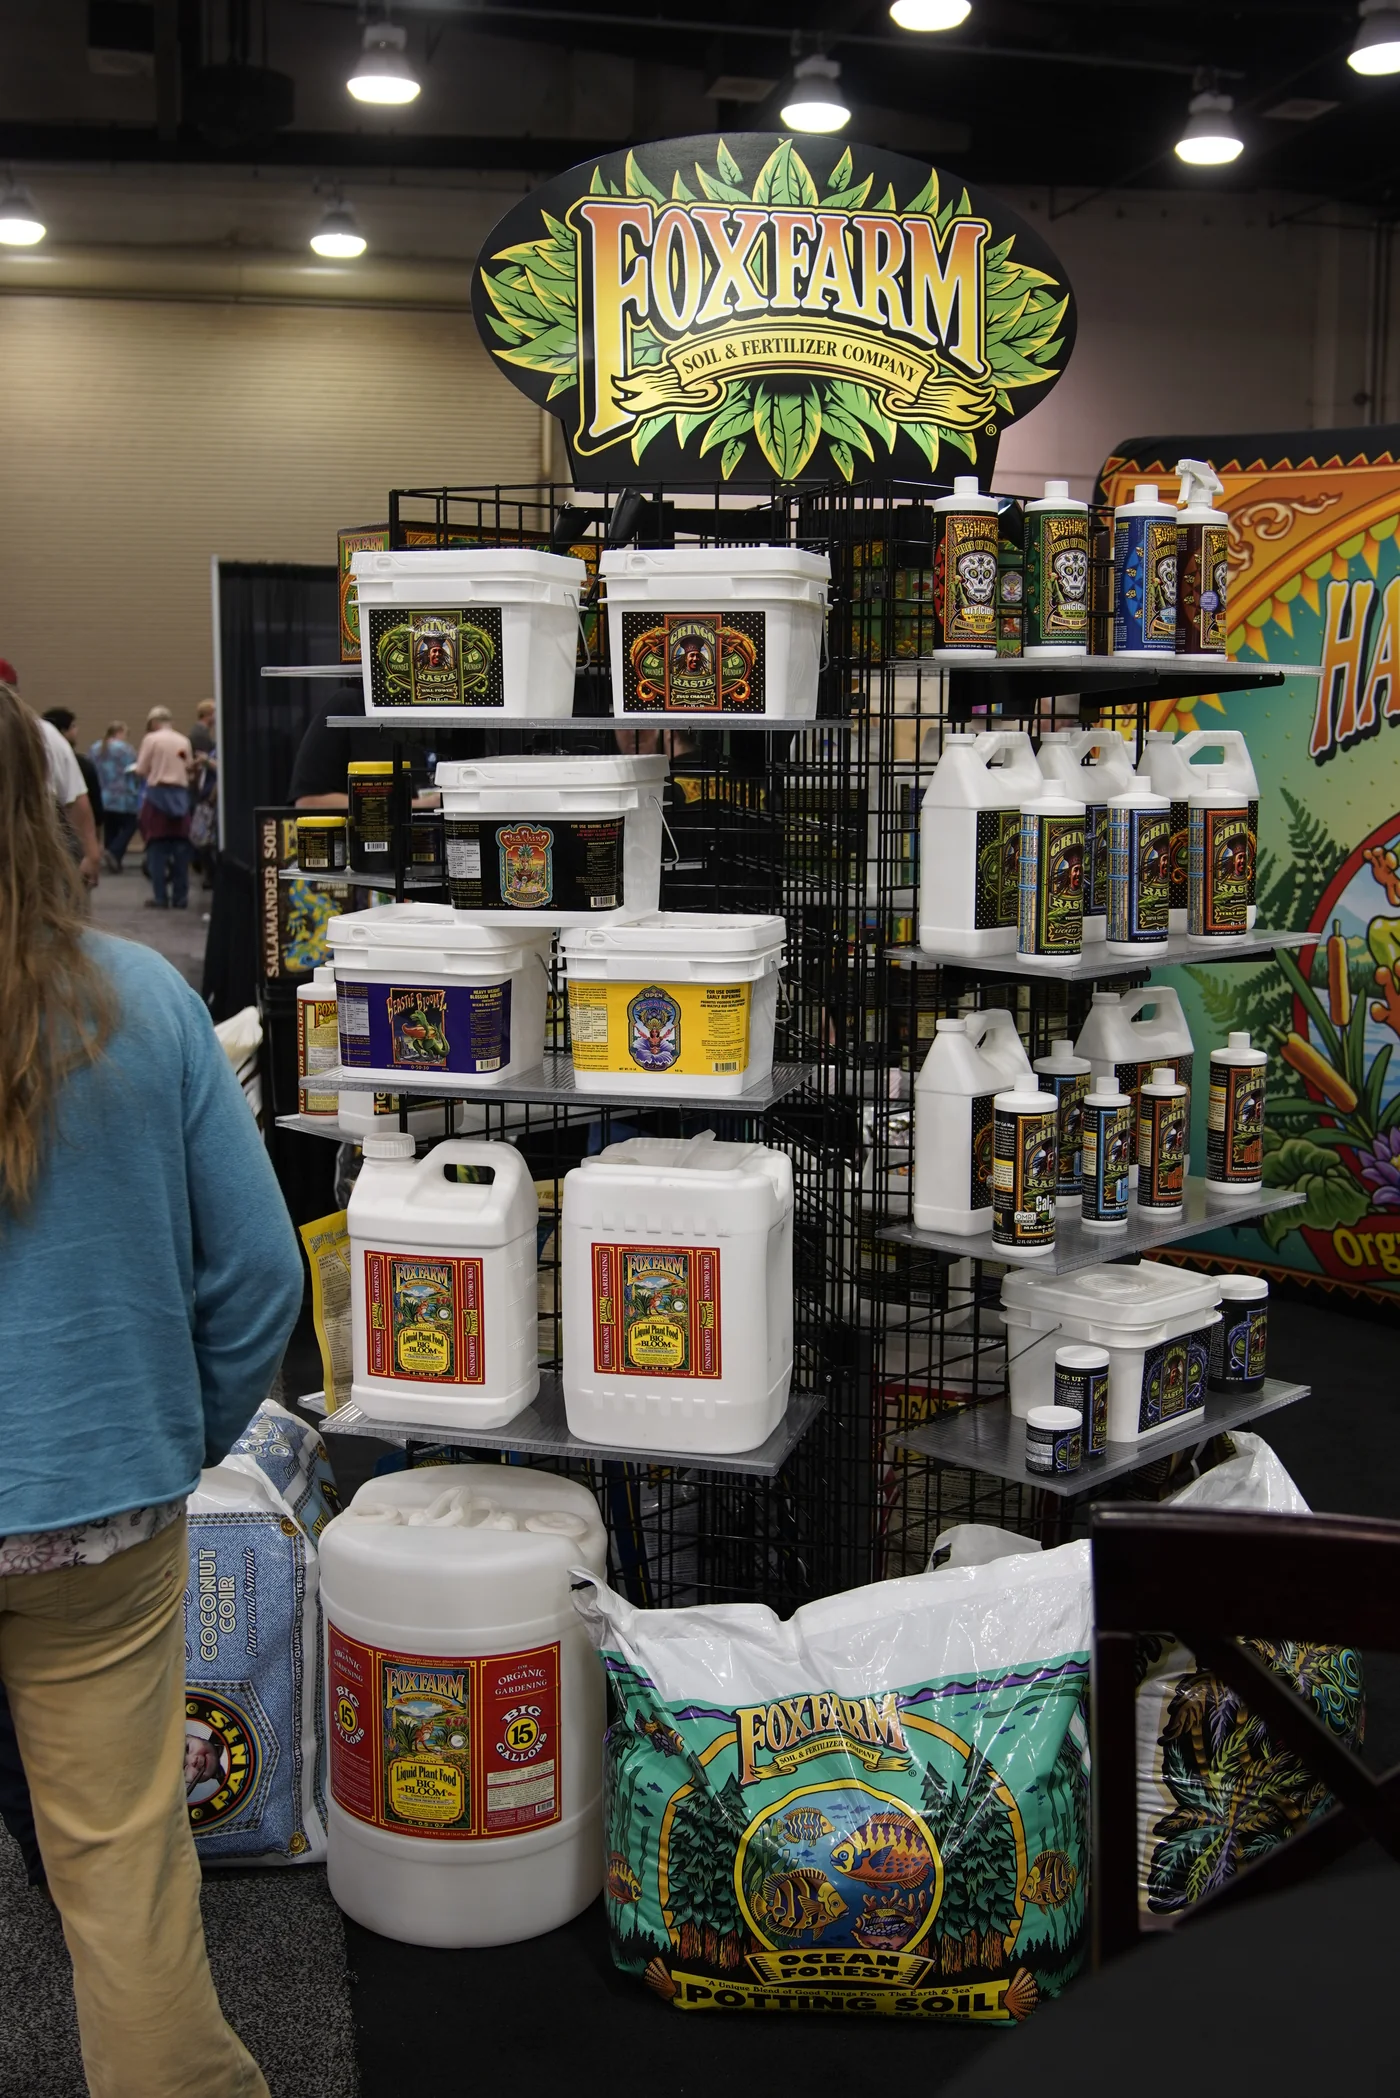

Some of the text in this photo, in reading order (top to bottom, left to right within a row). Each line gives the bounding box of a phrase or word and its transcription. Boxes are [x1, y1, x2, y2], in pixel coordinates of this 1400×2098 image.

[681, 337, 920, 384] SOIL & FERTILIZER COMPANY
[670, 624, 716, 645] GRINGO
[645, 656, 660, 668] 15
[726, 656, 740, 668] 15
[418, 672, 456, 682] RASTA
[672, 678, 714, 688] RASTA
[264, 820, 279, 978] SALAMANDER SOIL
[386, 993, 414, 1024] BEASTIE
[1015, 1213, 1036, 1221] OMRI
[1332, 1228, 1400, 1275] Org
[403, 1332, 444, 1346] Liquid Plant Food
[634, 1326, 678, 1340] Liquid Plant Food
[199, 1548, 218, 1662] COCONUT
[218, 1575, 236, 1634] COIR
[242, 1547, 258, 1658] Pure and Simple
[334, 1649, 361, 1672] ORGANIC
[494, 1679, 548, 1696] GARDENING
[497, 1668, 546, 1686] ORGANIC
[336, 1685, 360, 1708] BIG
[340, 1705, 354, 1728] 15
[501, 1704, 542, 1724] BIG
[333, 1710, 365, 1744] GALLONS
[511, 1722, 534, 1745] 15
[496, 1732, 548, 1762] GALLONS
[779, 1754, 798, 1764] SOIL
[805, 1740, 844, 1755] FERTILIZER
[845, 1741, 877, 1760] COMPANY
[396, 1766, 456, 1787] Liquid Plant Food
[416, 1779, 436, 1788] BIG
[405, 1786, 446, 1797] BLOOM
[778, 1952, 900, 1968] OCEAN
[780, 1966, 899, 1980] FOREST
[686, 1984, 994, 2013] POTTING SOIL
[718, 1981, 750, 1992] Unique
[752, 1984, 780, 1994] Blend
[782, 1988, 792, 1996] of
[824, 1990, 857, 1998] Things
[911, 1989, 938, 1997] Earth
[940, 1987, 949, 1995] &
[952, 1986, 974, 1994] Sea"
